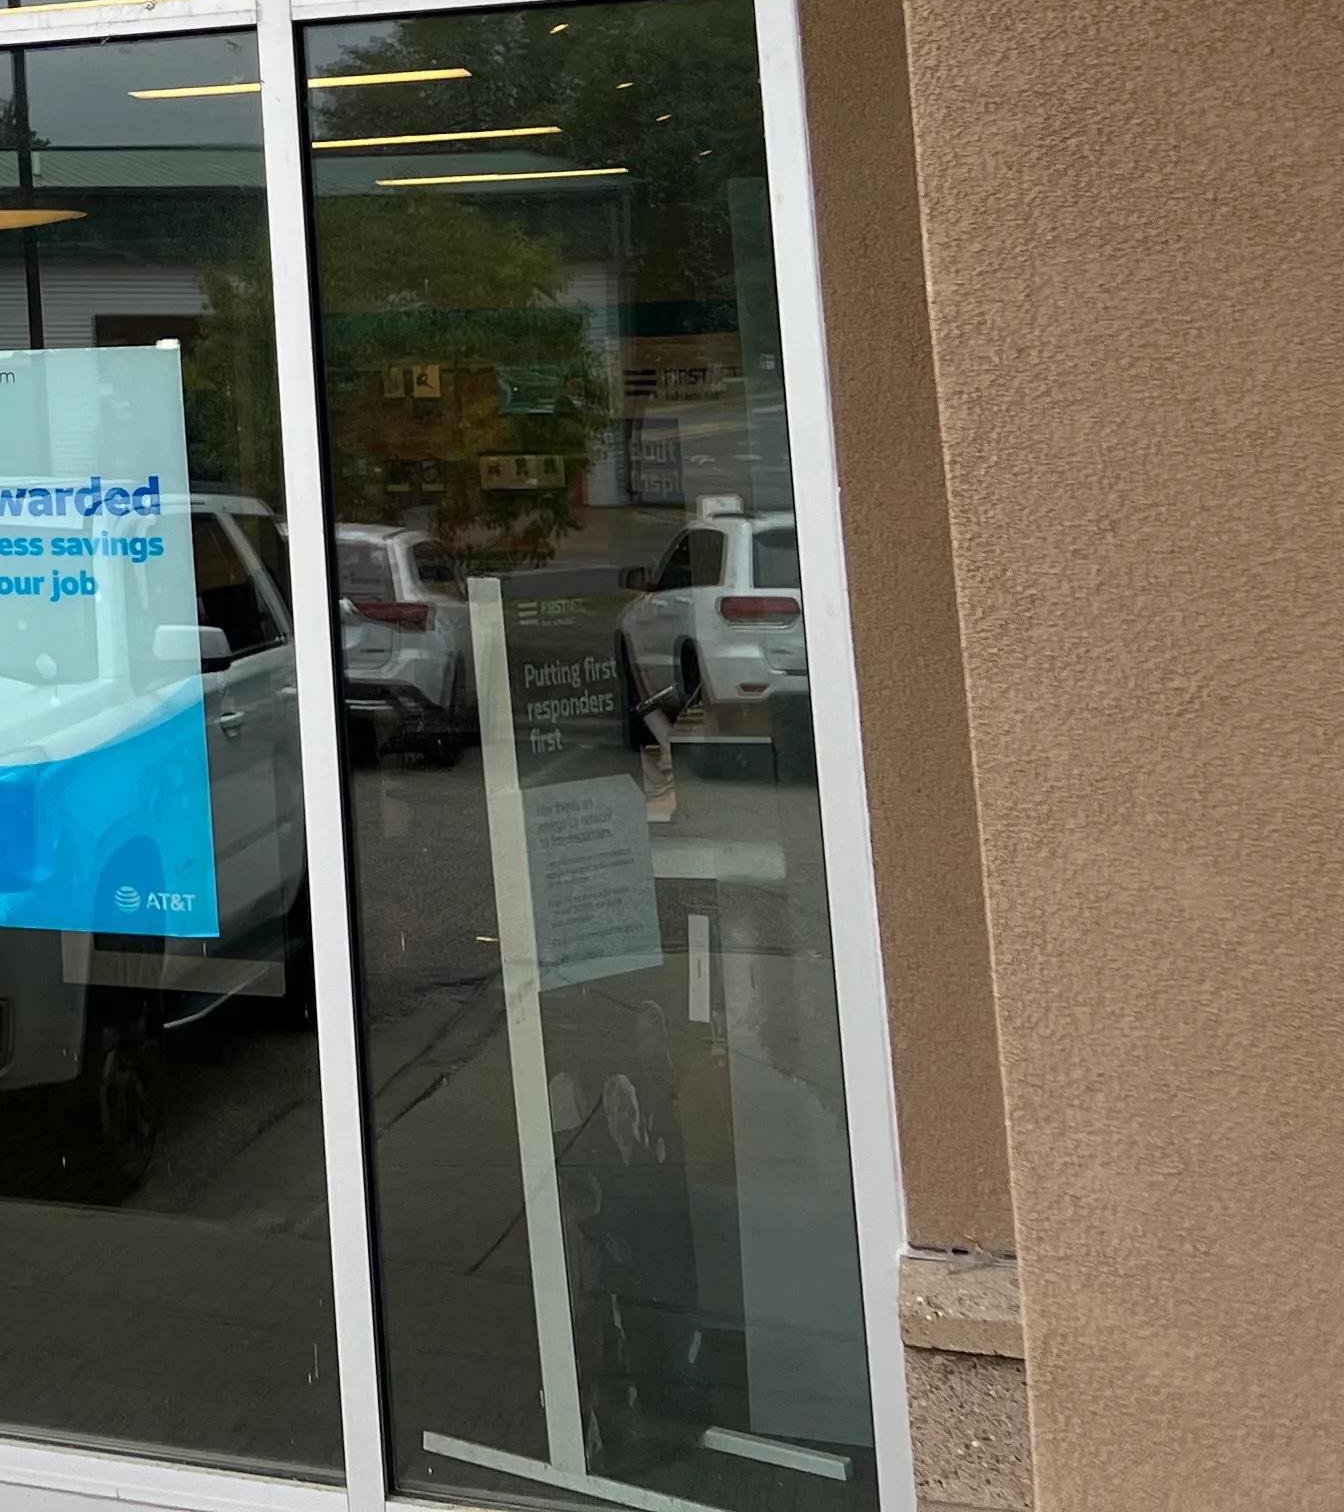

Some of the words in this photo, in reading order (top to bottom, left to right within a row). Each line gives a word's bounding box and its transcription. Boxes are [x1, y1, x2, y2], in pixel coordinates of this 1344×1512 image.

[51, 530, 165, 563] savings
[50, 569, 98, 602] job
[524, 659, 581, 689] Putting
[584, 656, 618, 682] first
[527, 688, 614, 723] responders
[530, 727, 563, 755] first
[145, 891, 196, 912] AT&T
